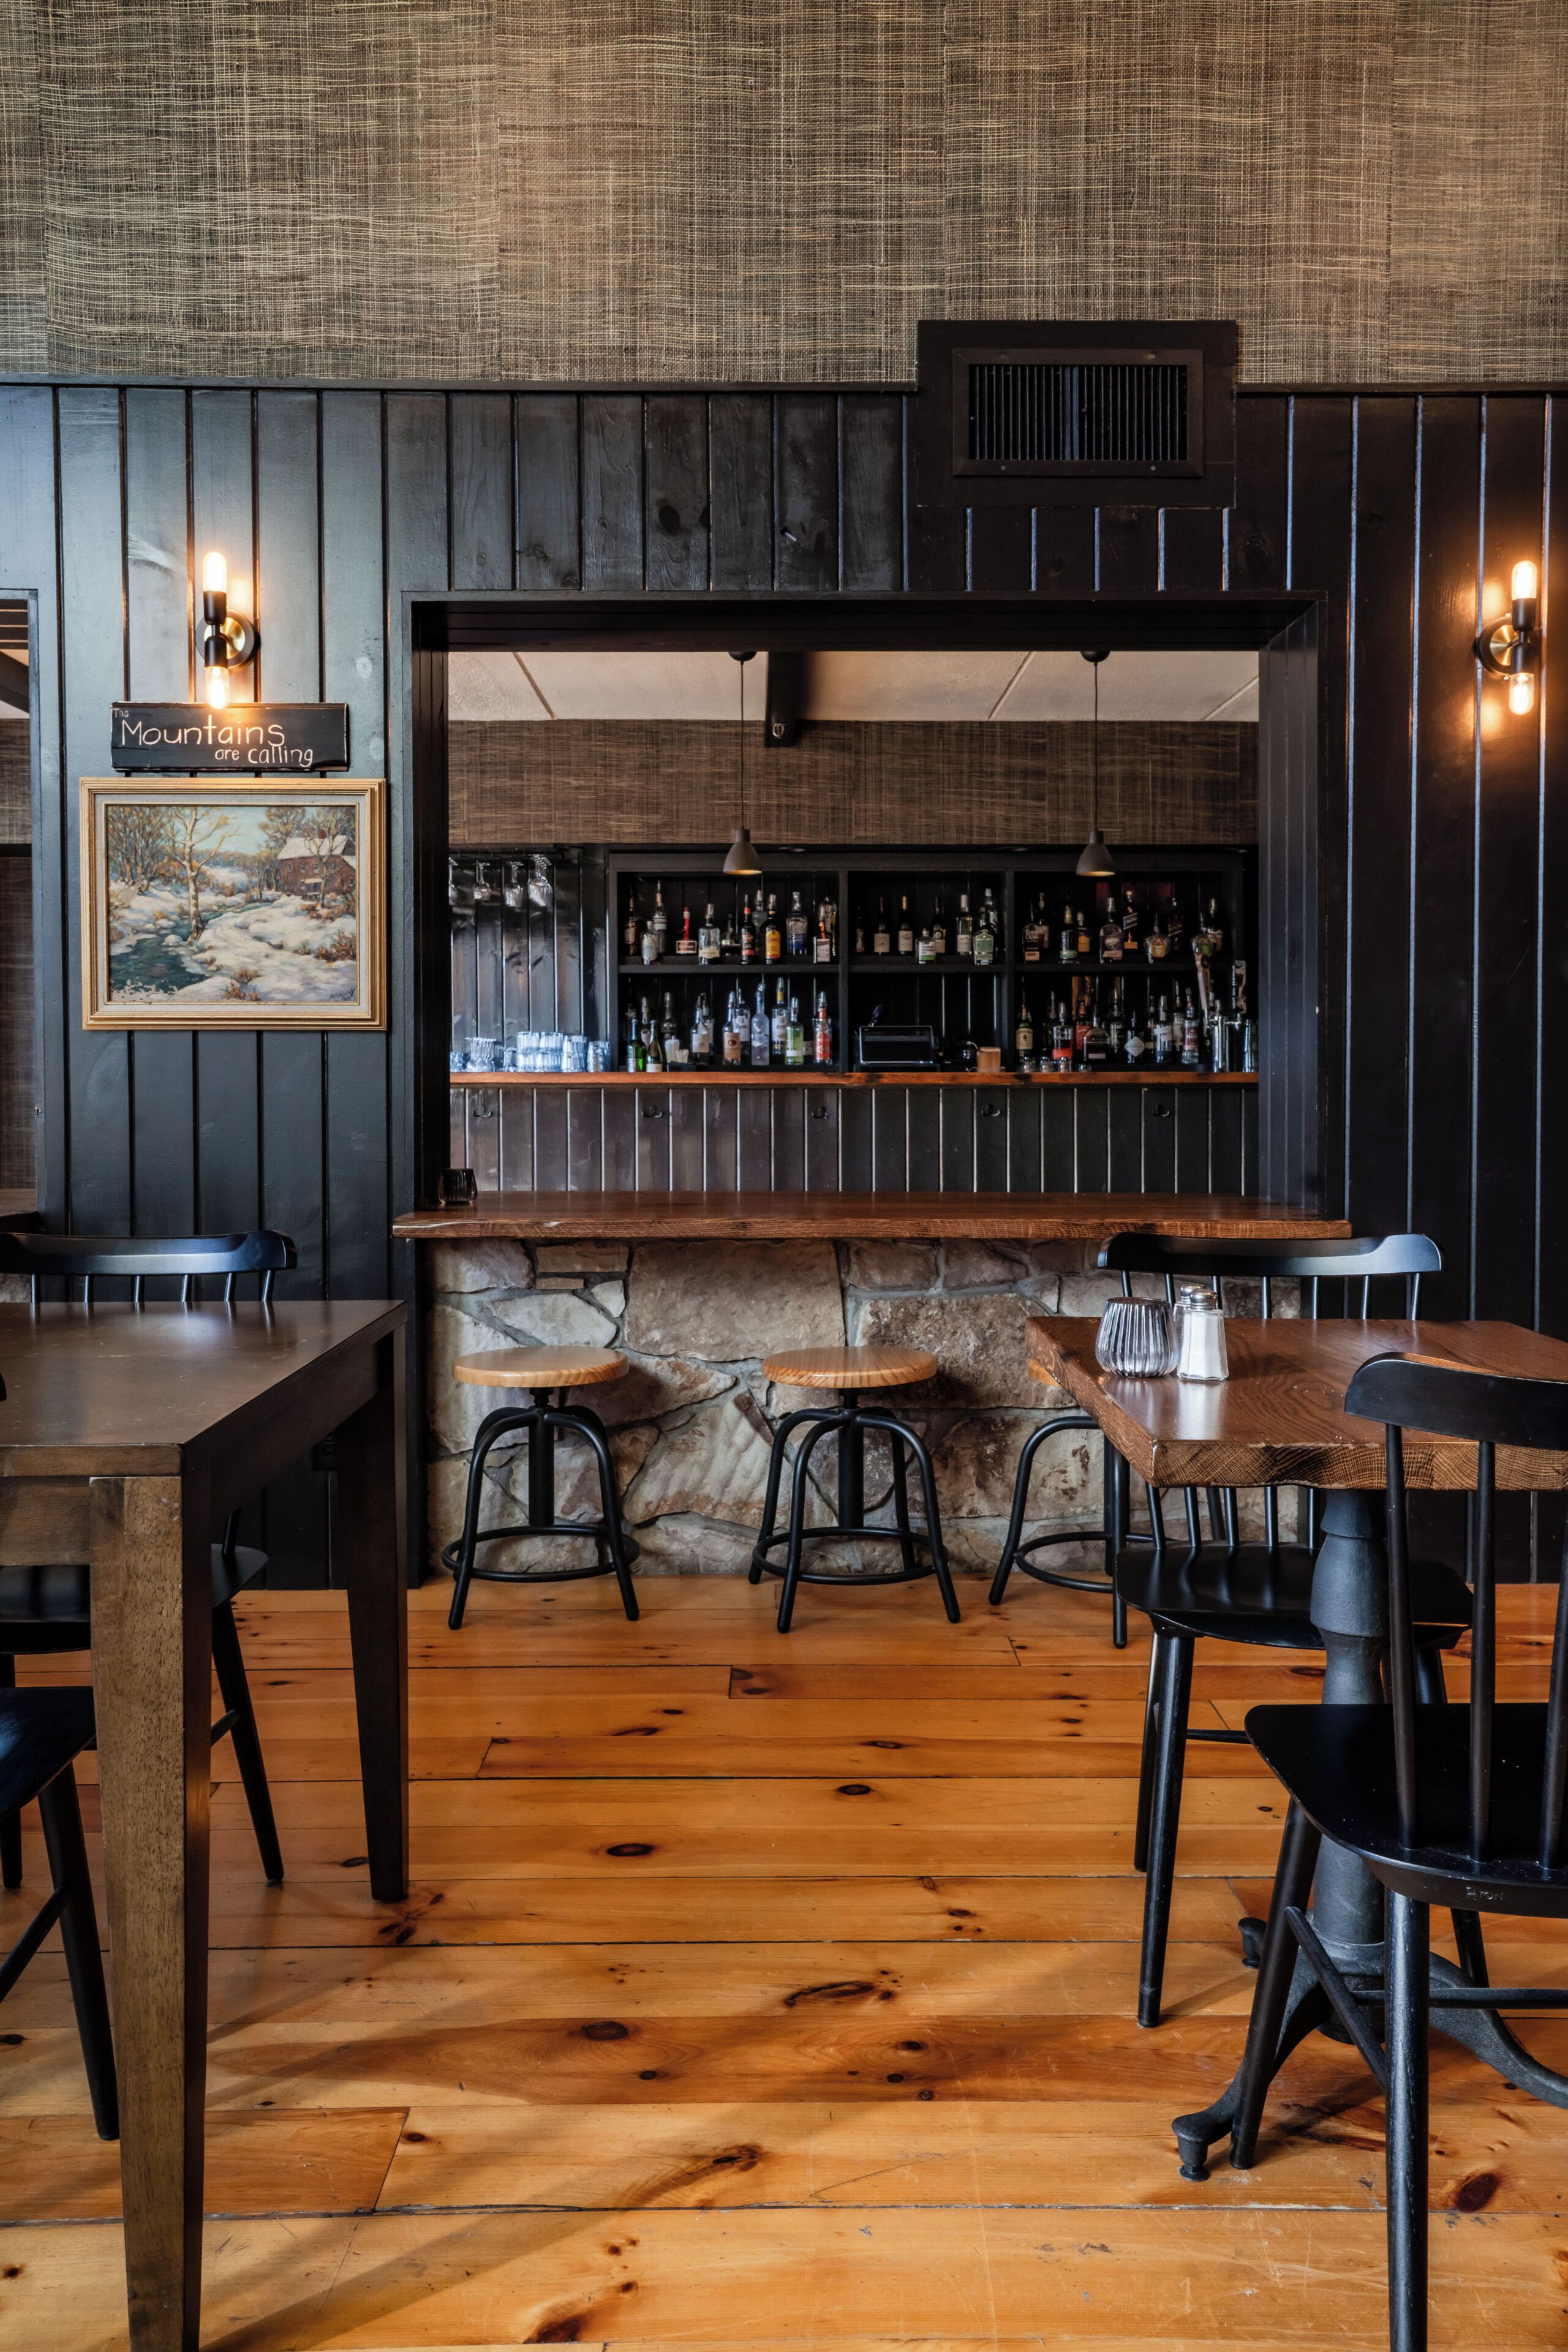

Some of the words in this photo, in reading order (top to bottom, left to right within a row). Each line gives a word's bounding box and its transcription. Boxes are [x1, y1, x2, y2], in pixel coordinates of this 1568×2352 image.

[112, 708, 129, 718] The
[122, 714, 285, 747] Mountains
[215, 749, 239, 761] are
[248, 746, 314, 767] calling
